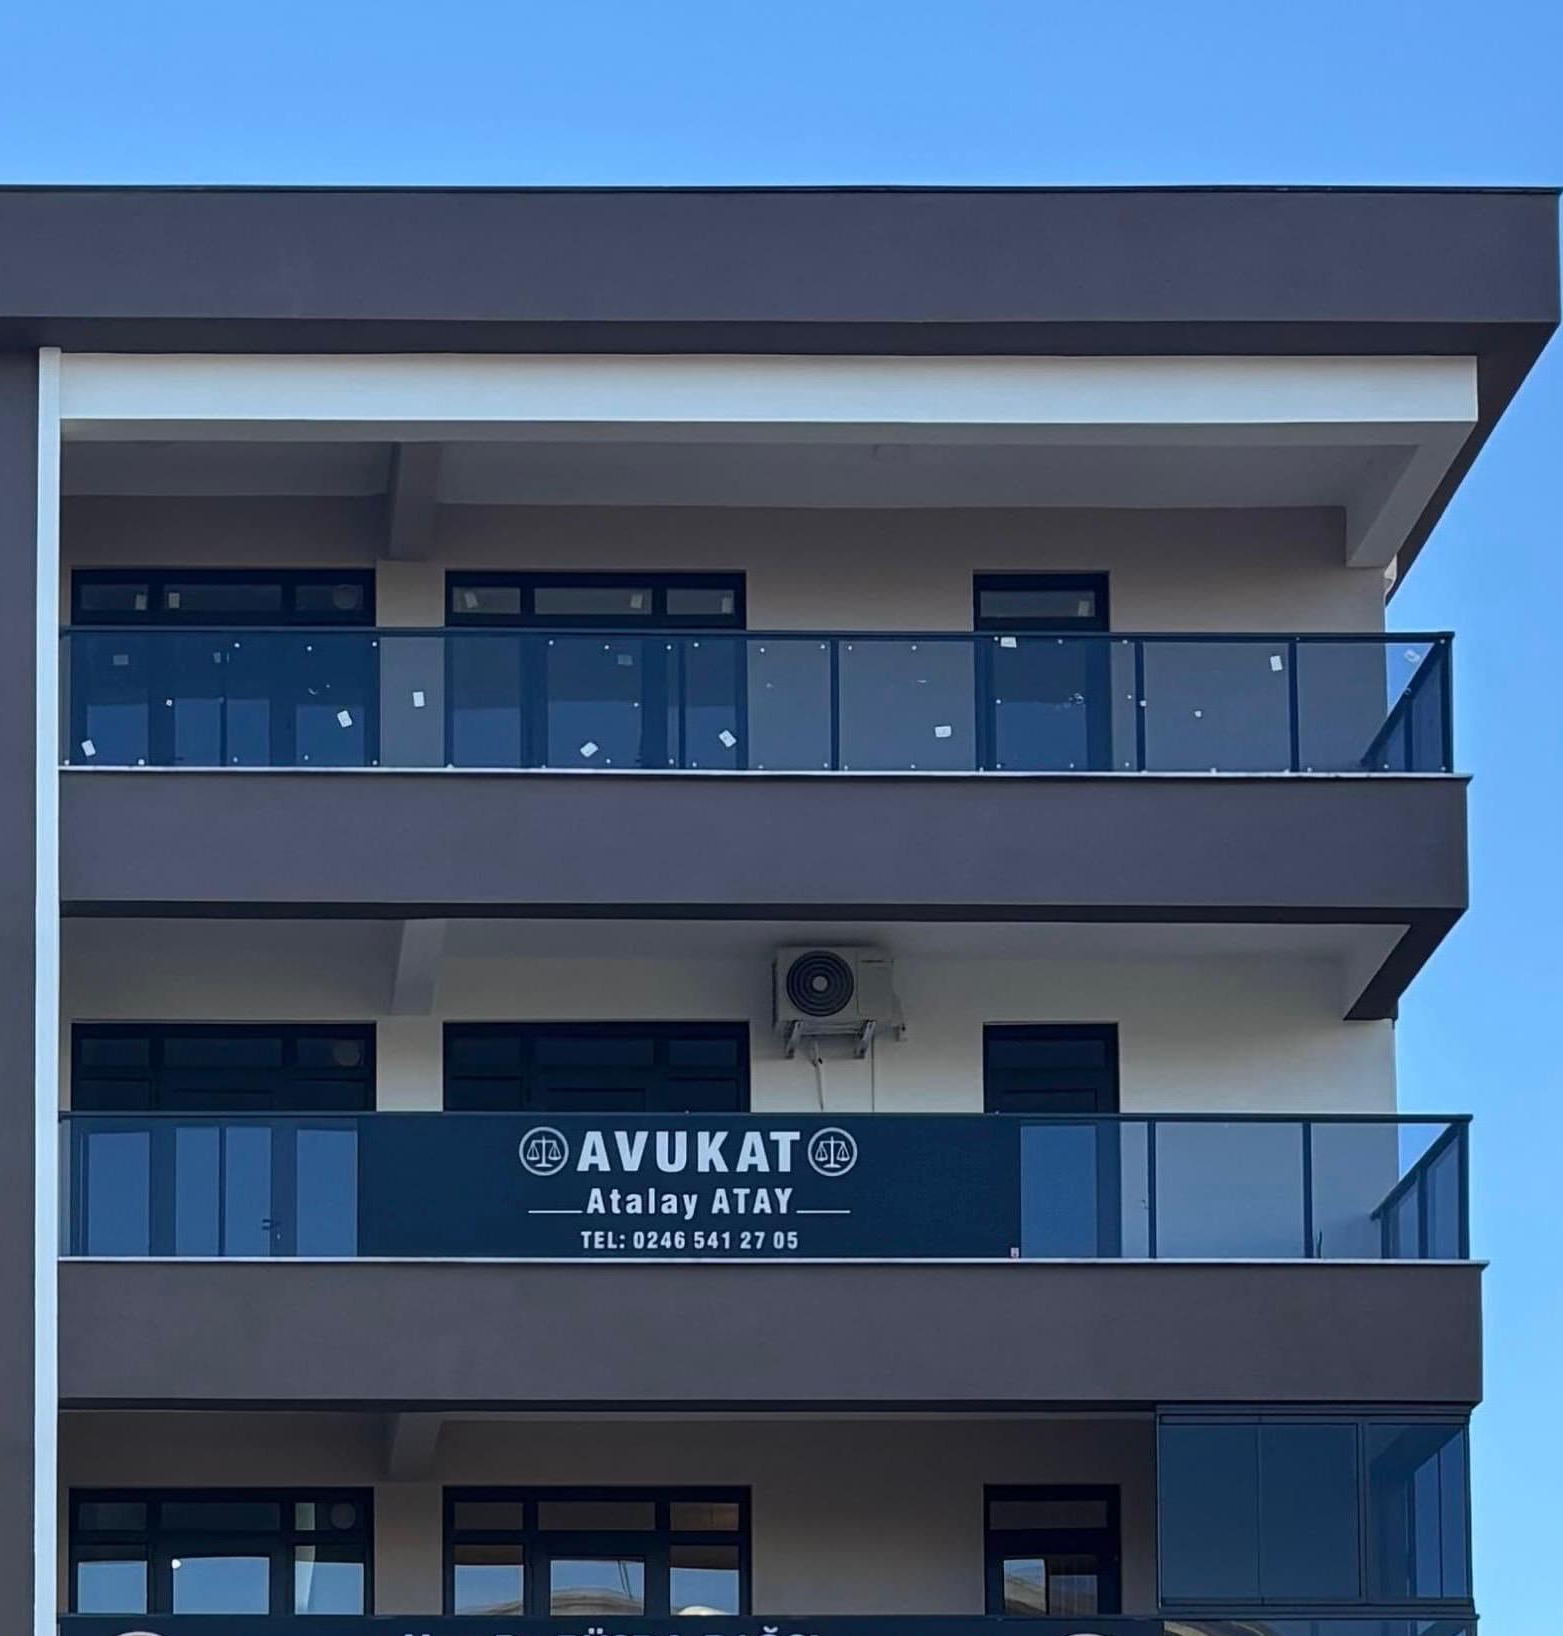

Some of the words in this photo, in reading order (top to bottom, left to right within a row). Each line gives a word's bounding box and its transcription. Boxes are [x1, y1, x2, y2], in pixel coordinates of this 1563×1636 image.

[576, 1130, 801, 1173] AVUKAT
[586, 1187, 698, 1220] Atalay
[711, 1187, 793, 1214] ATAY
[580, 1231, 626, 1249] TEL:
[633, 1231, 686, 1249] 0246
[694, 1231, 730, 1249] 541
[740, 1231, 765, 1249] 27
[773, 1231, 798, 1249] 05
